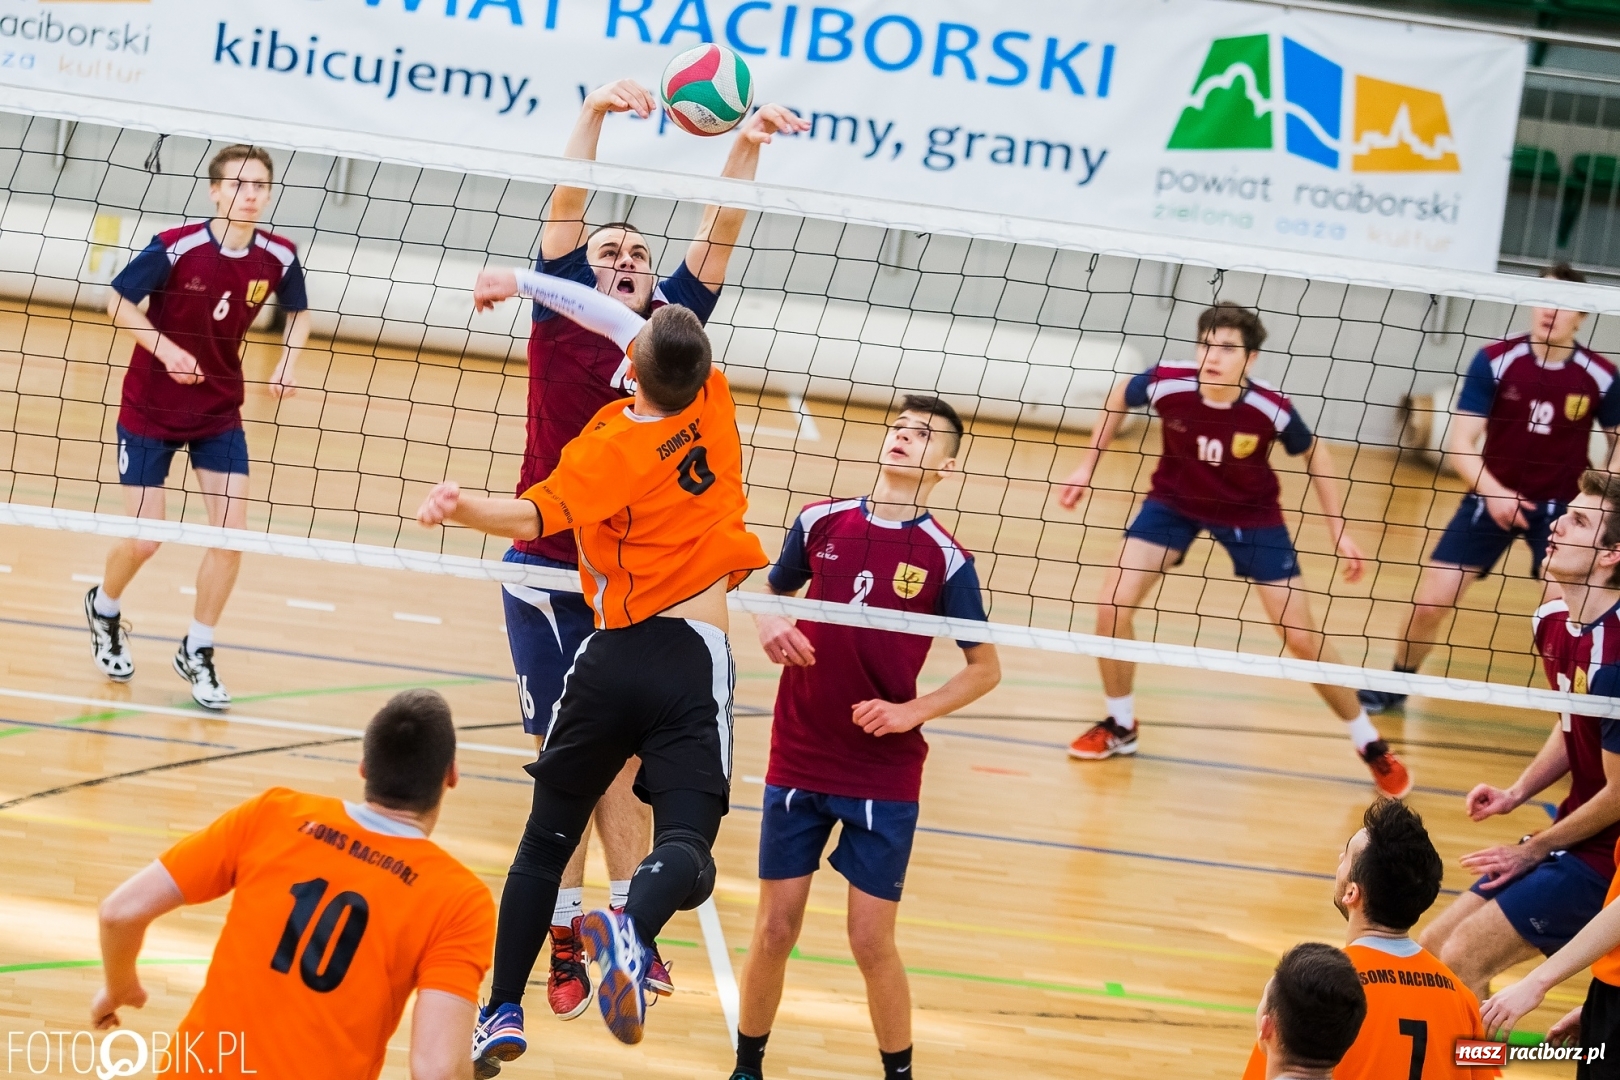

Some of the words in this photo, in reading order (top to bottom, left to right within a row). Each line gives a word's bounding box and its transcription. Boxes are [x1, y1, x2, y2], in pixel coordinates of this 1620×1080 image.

[605, 0, 1117, 99] RACIBORSKI
[58, 54, 146, 84] kultur
[213, 21, 539, 116] kibicujemy,
[922, 124, 1109, 186] gramy
[1156, 166, 1272, 201] powiat
[1294, 182, 1463, 224] raciborski
[1153, 202, 1255, 229] zielona
[213, 291, 232, 321] 6
[1528, 400, 1555, 435] 12
[118, 439, 129, 475] 6
[656, 429, 691, 461] ZSOMS
[1197, 436, 1223, 466] 10
[849, 570, 874, 606] 2
[297, 821, 349, 851] ZSOMS
[348, 839, 419, 887] RACIBÓRZ
[270, 877, 370, 993] 10
[1398, 1018, 1428, 1080] 7
